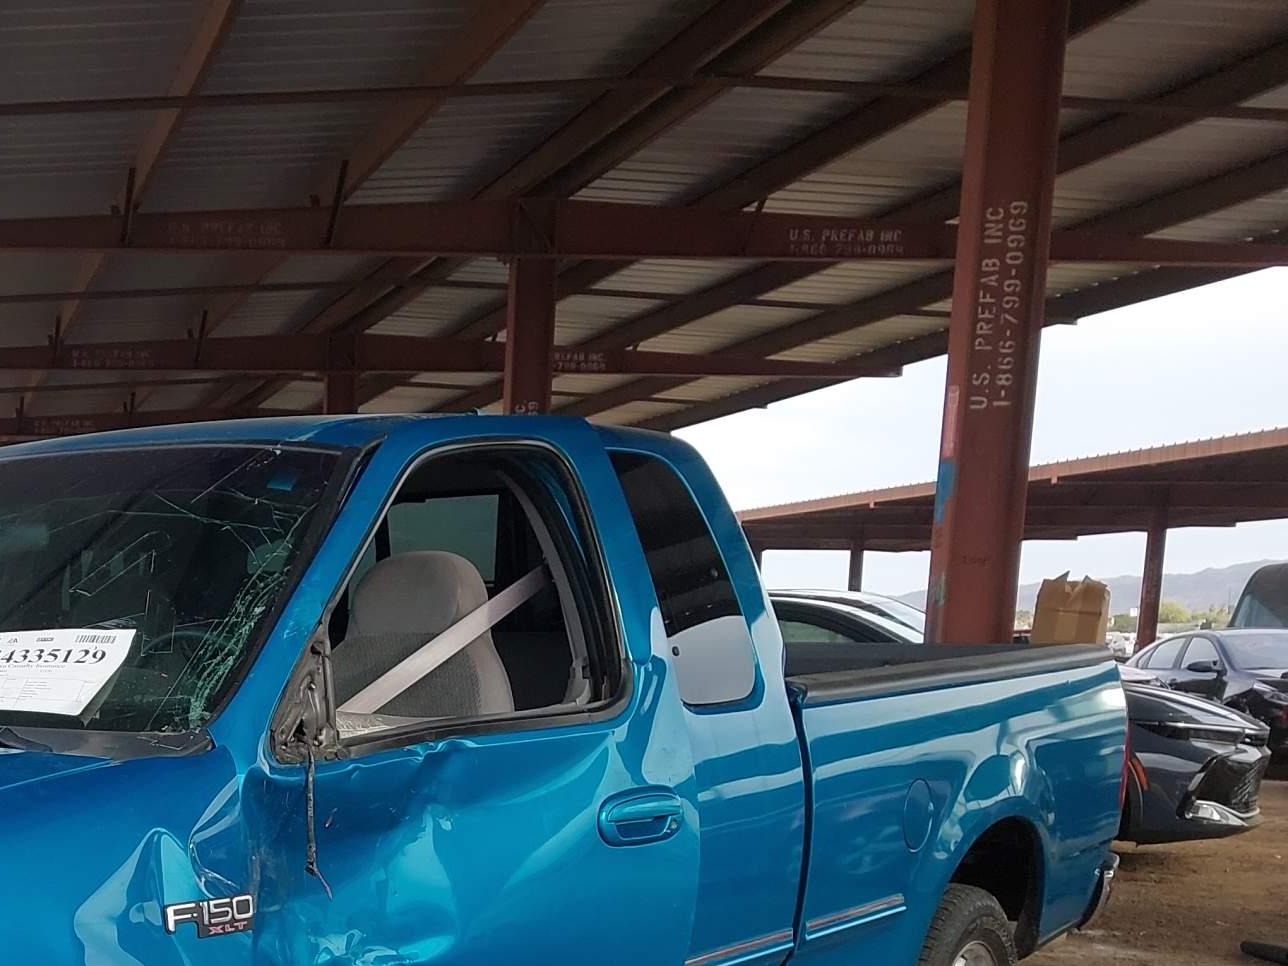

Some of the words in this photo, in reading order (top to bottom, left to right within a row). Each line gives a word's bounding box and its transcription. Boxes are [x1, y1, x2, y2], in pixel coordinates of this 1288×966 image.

[821, 228, 874, 241] PREFAB
[984, 206, 1005, 244] INC
[974, 257, 1001, 351] PREFAB
[969, 366, 992, 410] U.S.
[167, 895, 253, 931] F-150
[208, 921, 247, 934] XLT
